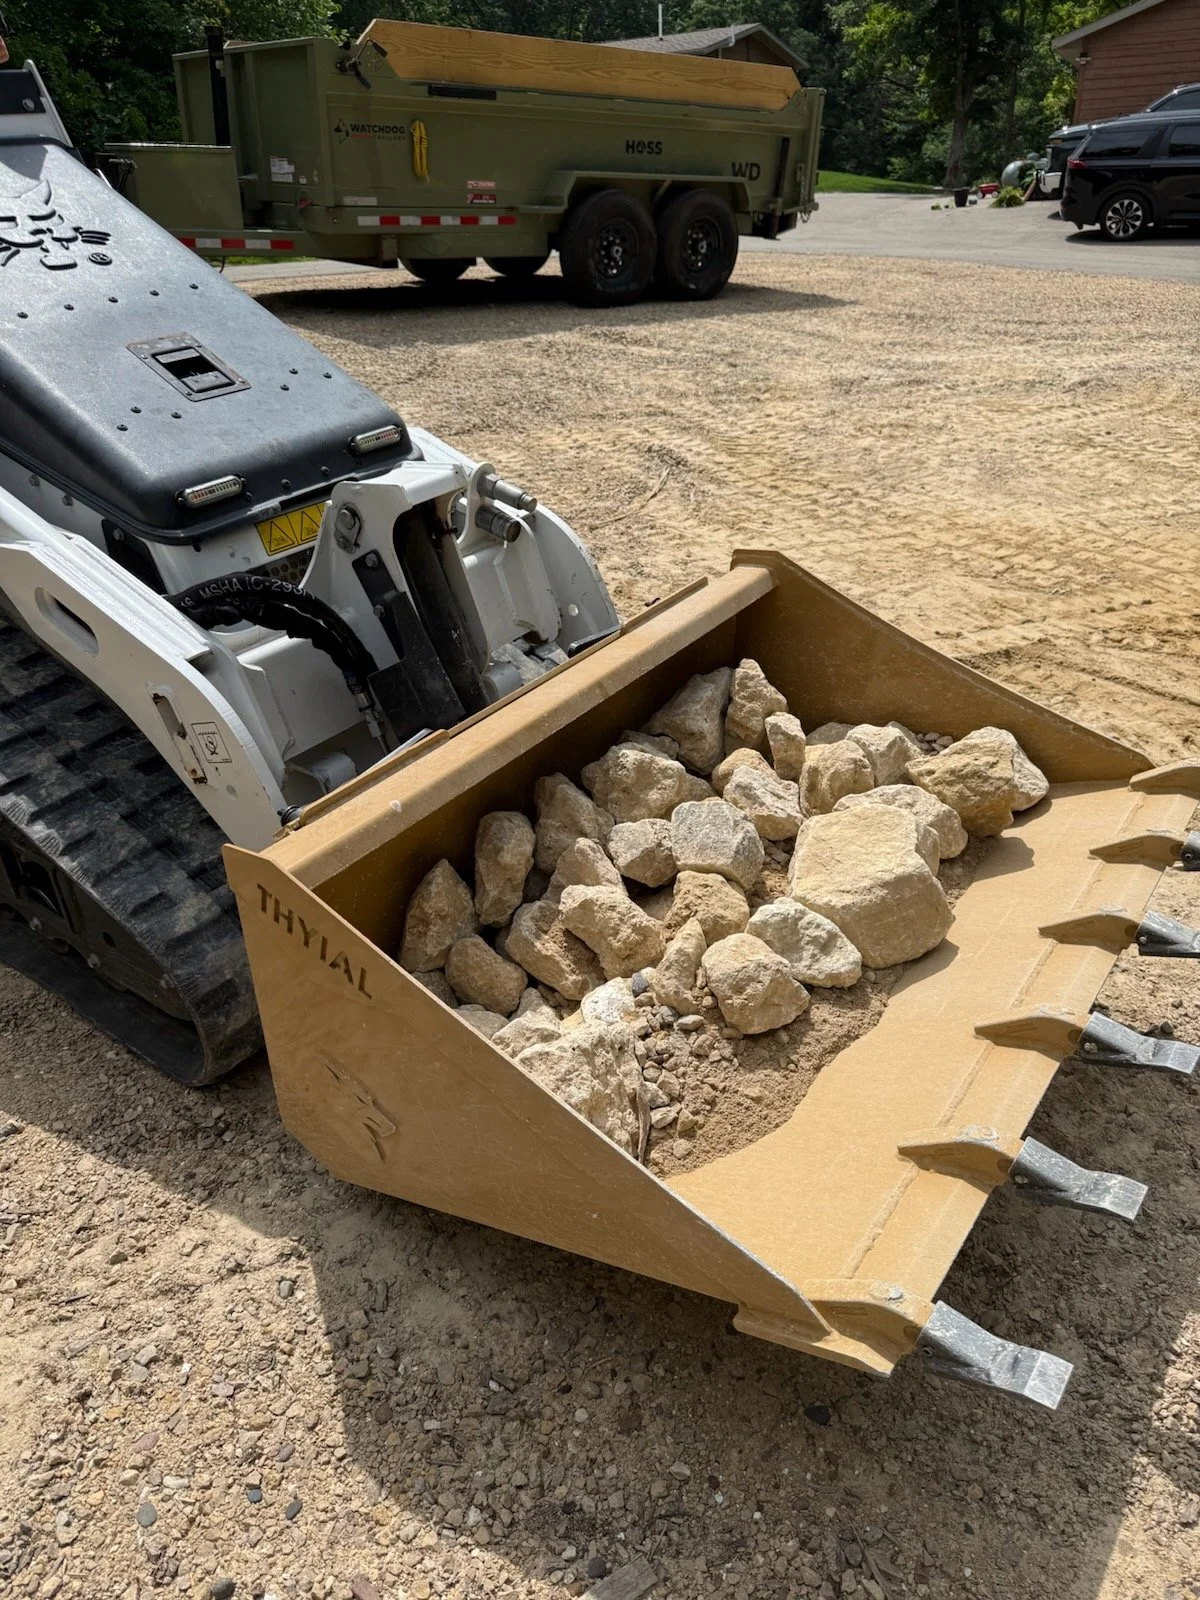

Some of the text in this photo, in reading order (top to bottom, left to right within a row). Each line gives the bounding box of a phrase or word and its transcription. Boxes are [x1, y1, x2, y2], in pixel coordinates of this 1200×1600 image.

[350, 123, 405, 134] WATCHDOG
[625, 139, 663, 155] HOSS
[731, 161, 761, 181] WD
[199, 577, 244, 599] MSHA
[257, 883, 373, 1000] THYIAL
